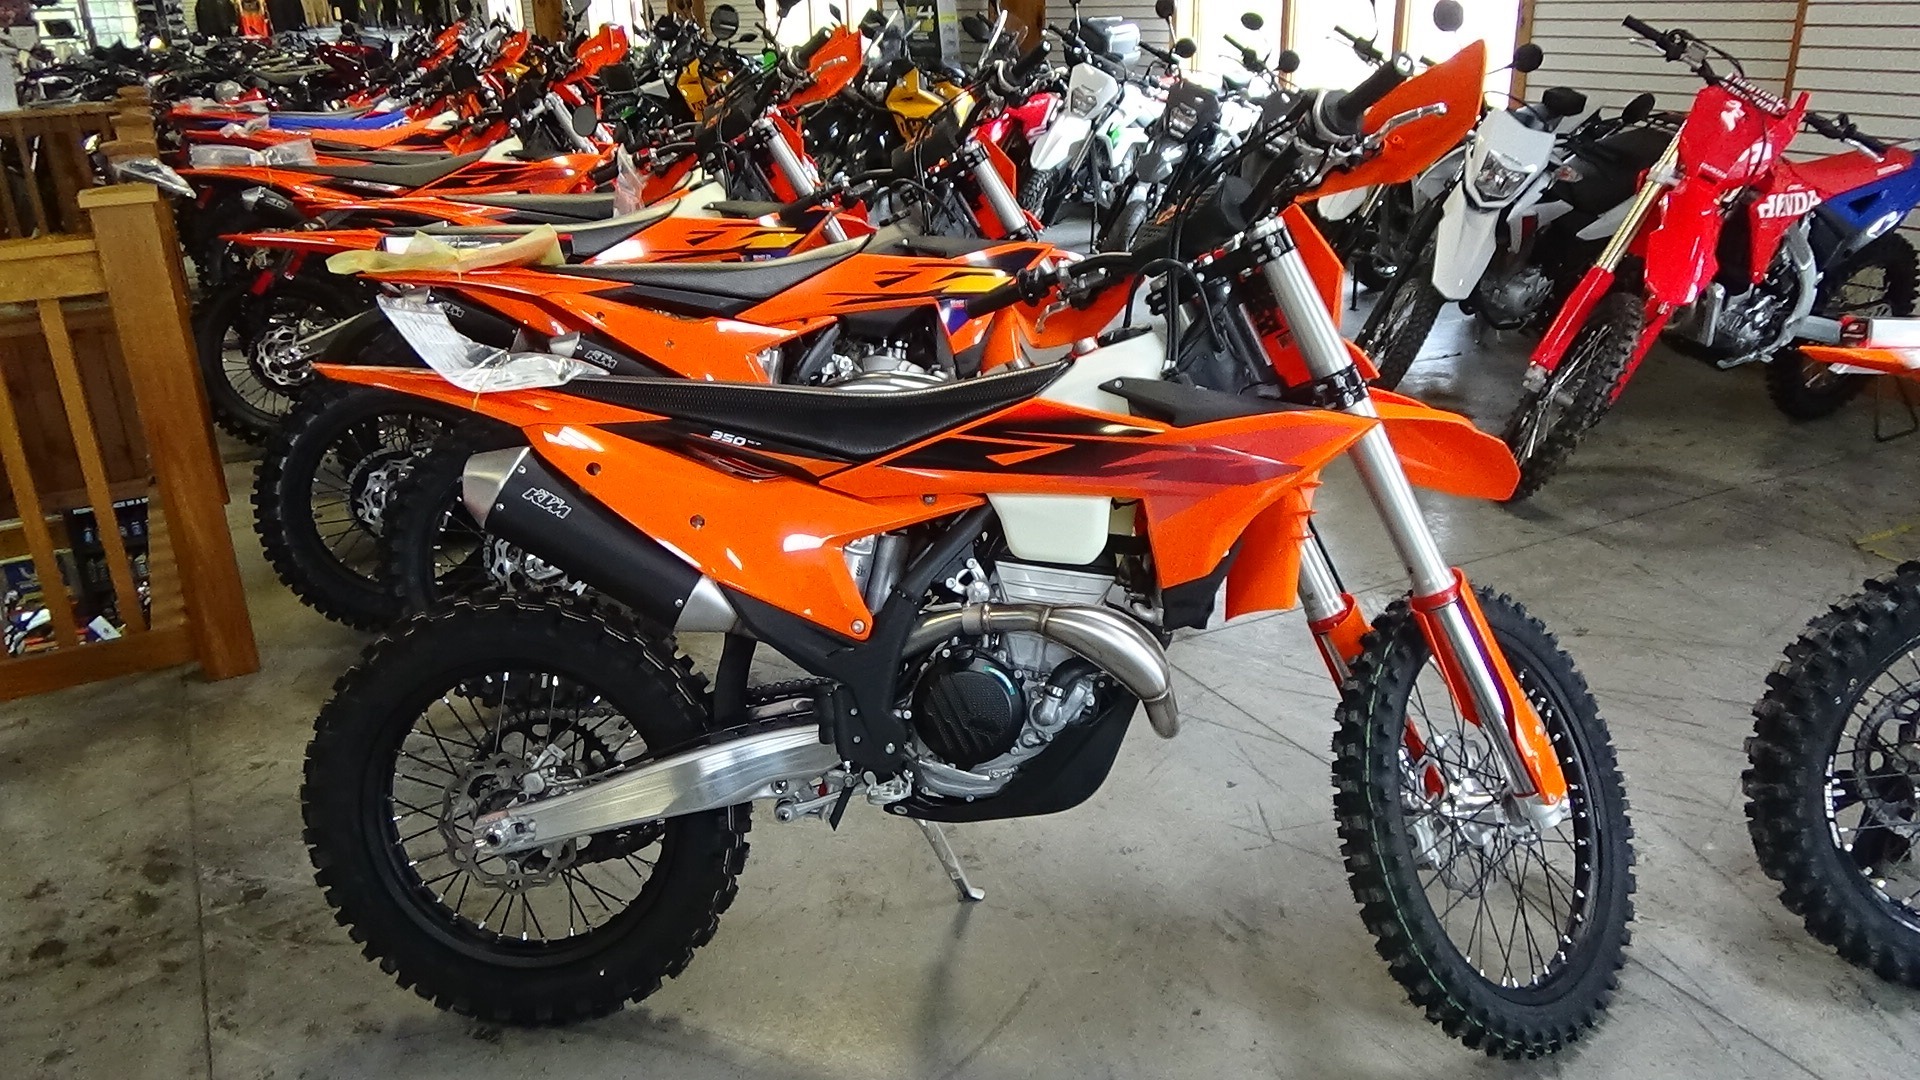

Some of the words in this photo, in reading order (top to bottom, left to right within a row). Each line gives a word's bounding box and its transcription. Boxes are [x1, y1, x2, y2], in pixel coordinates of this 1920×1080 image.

[1757, 189, 1822, 219] HONDA
[710, 430, 747, 447] 350
[521, 487, 572, 519] KTM
